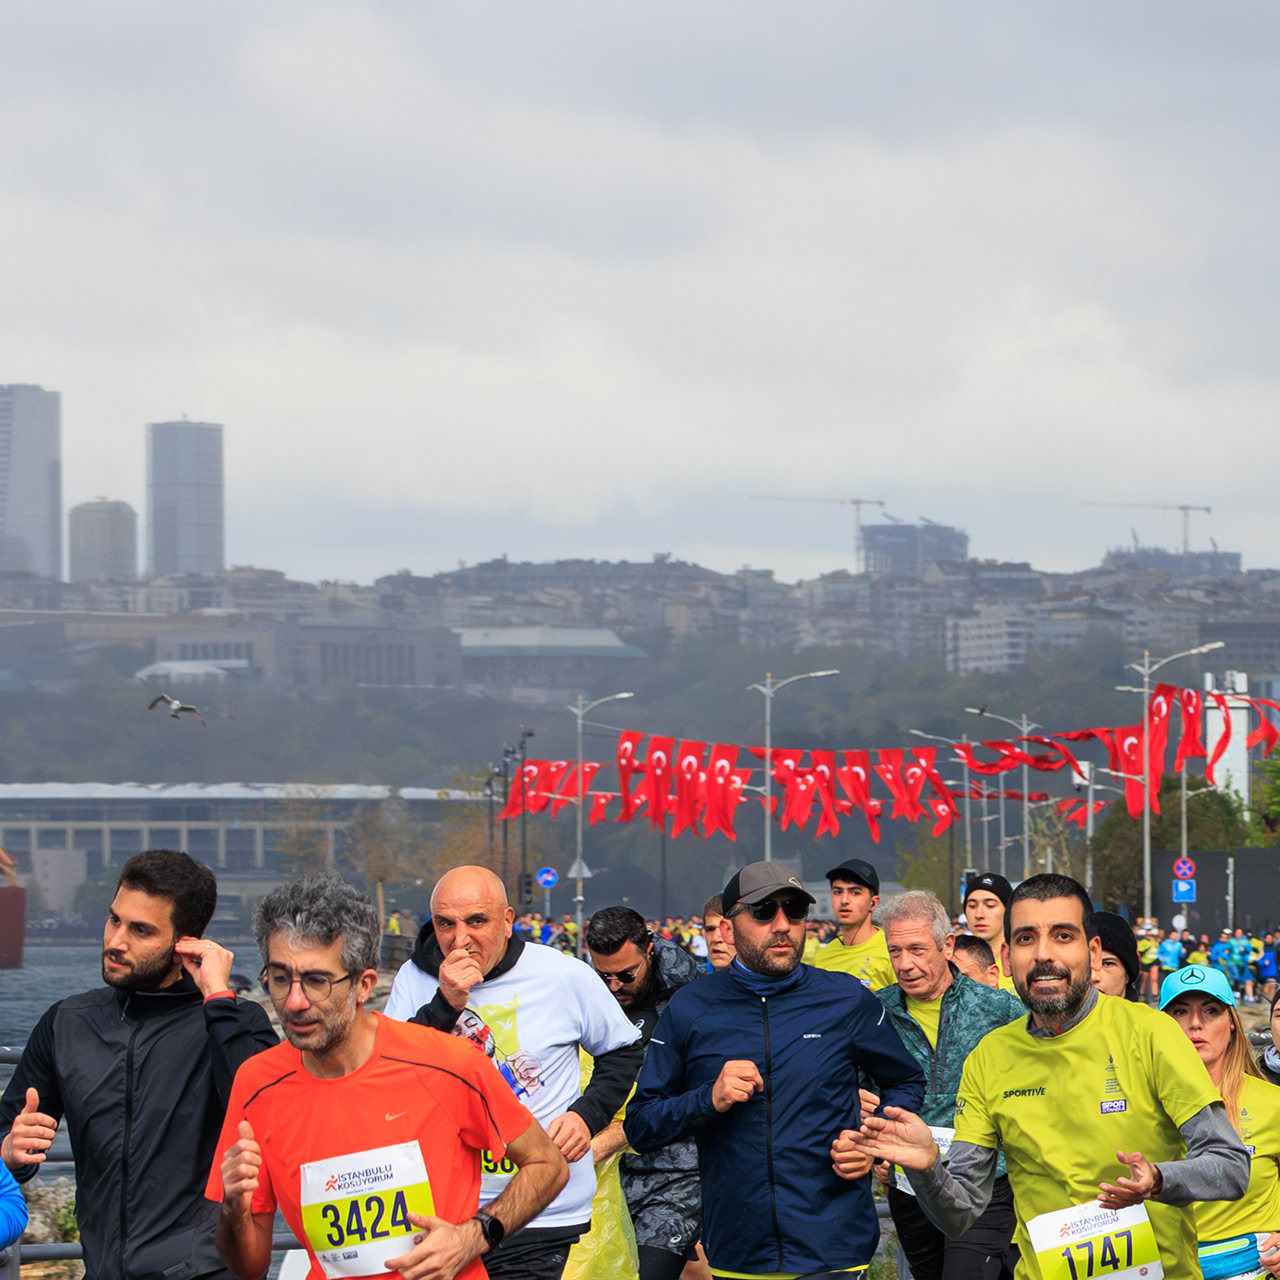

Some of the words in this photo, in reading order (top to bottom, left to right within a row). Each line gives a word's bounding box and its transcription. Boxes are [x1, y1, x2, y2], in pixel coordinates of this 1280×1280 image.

[1003, 1086, 1046, 1098] SPORTIVE
[1102, 1100, 1125, 1108] SPOR
[338, 1164, 392, 1182] İSTANBULU
[322, 1190, 412, 1247] 3424
[1070, 1210, 1118, 1228] İSTANBULU
